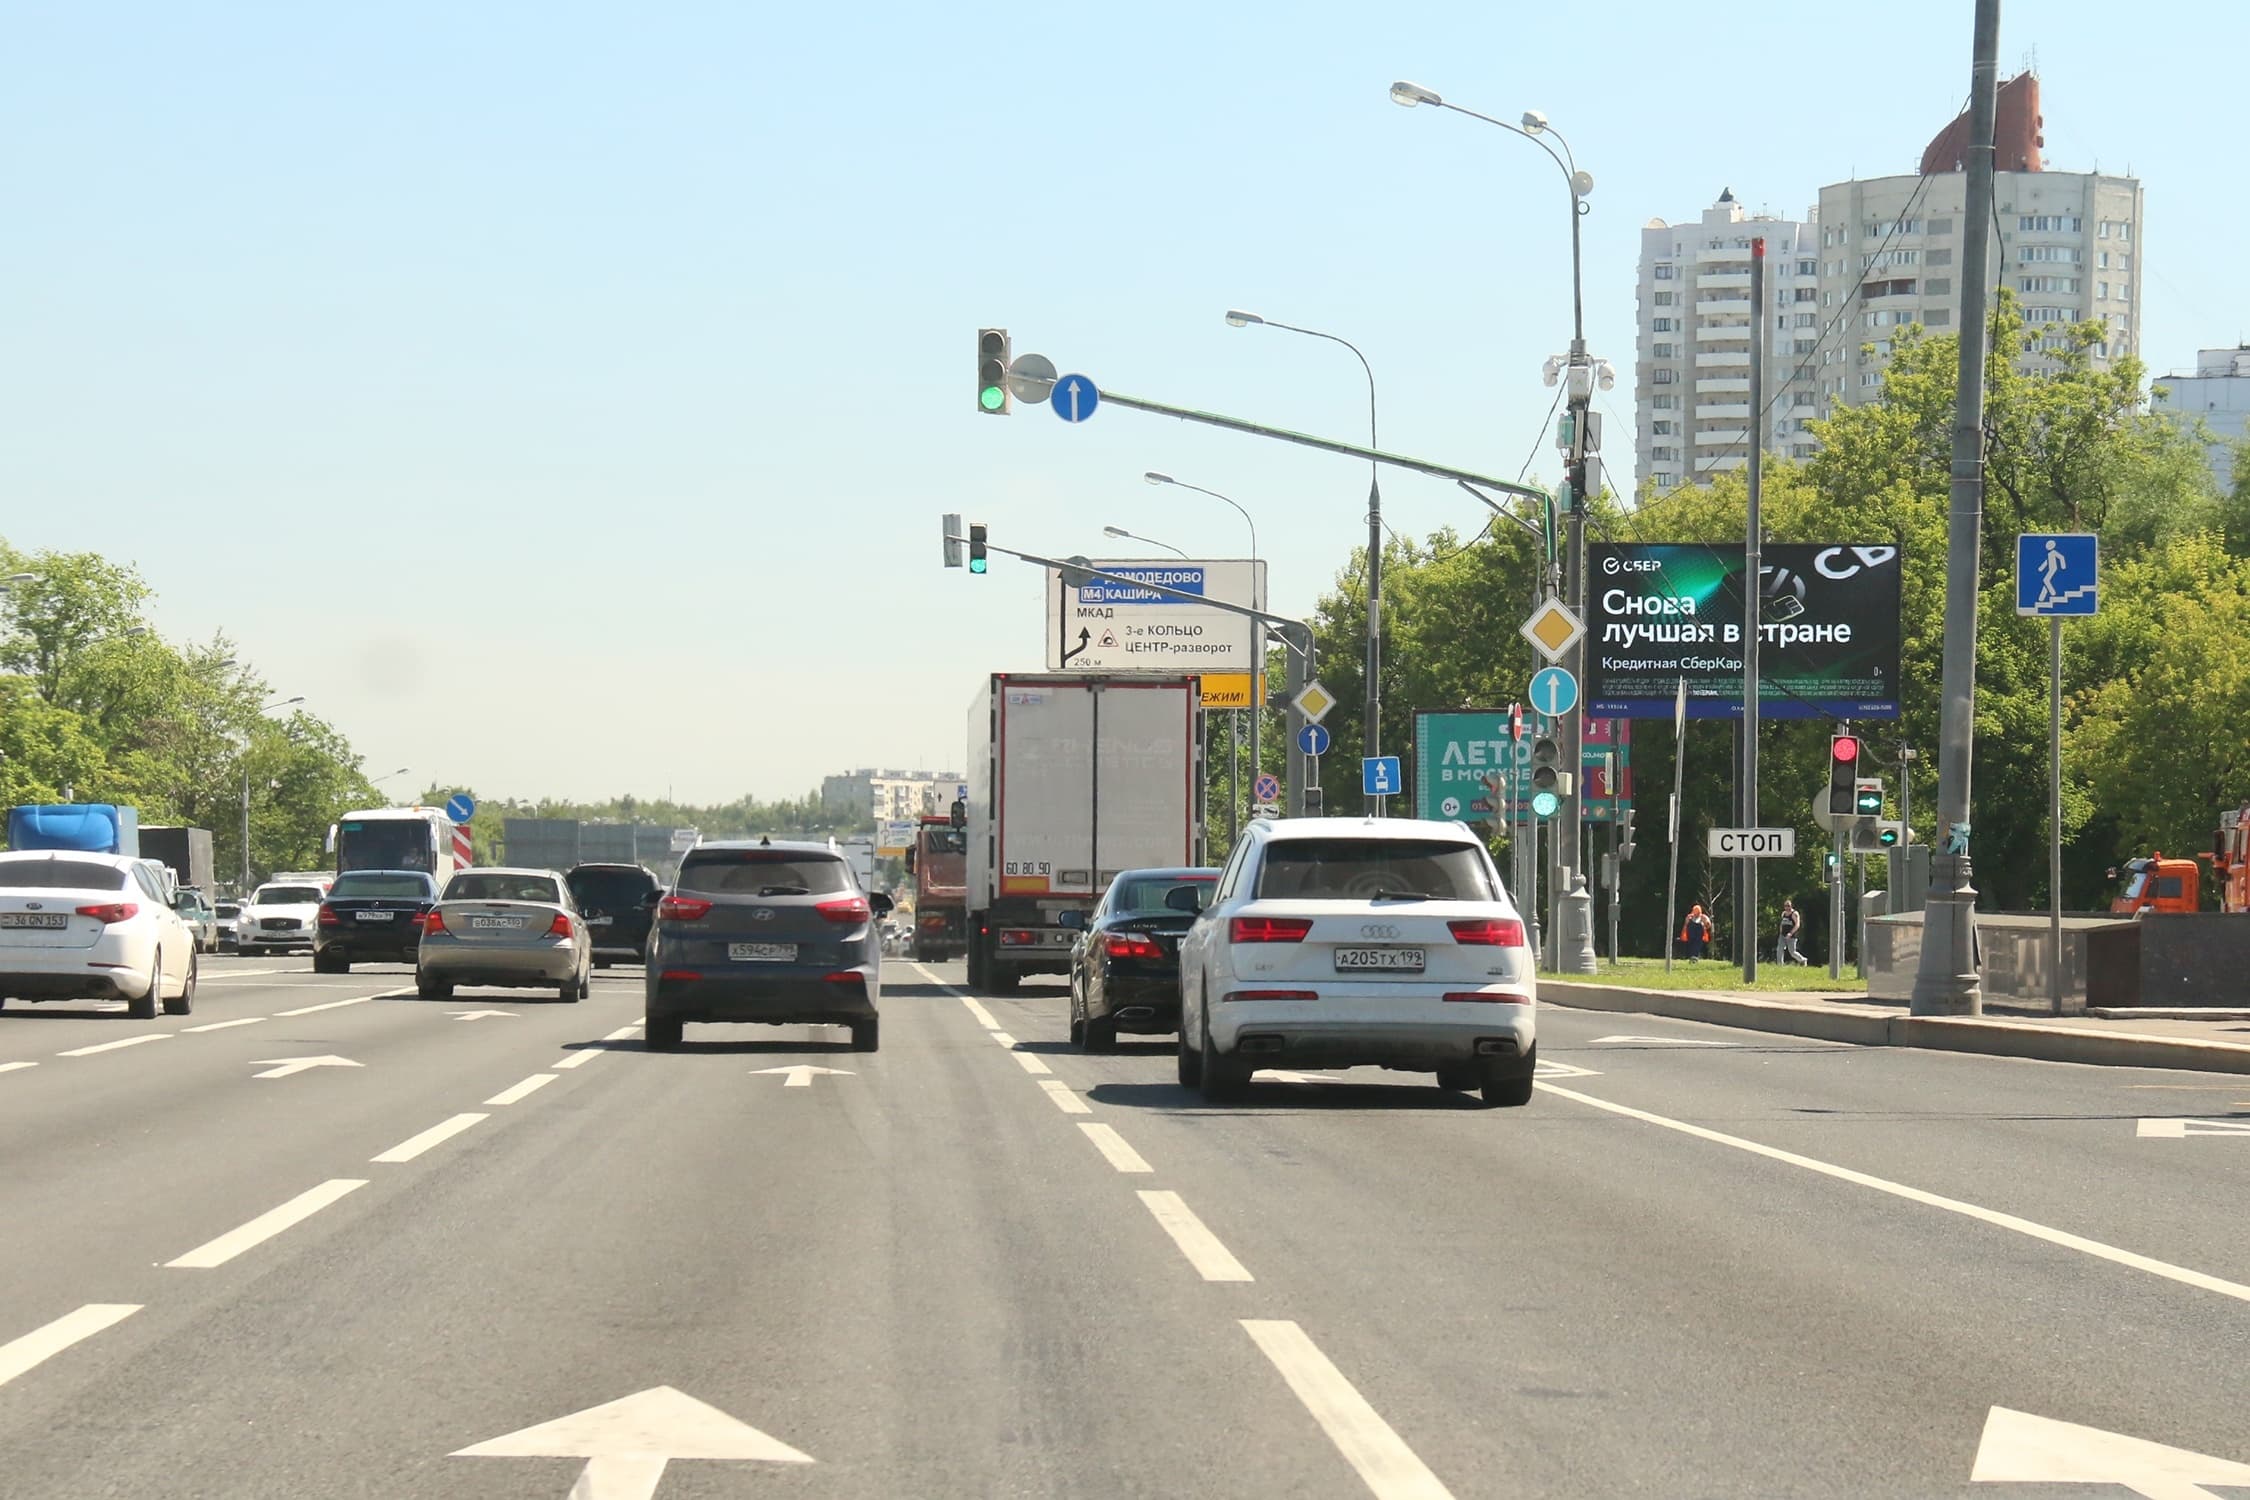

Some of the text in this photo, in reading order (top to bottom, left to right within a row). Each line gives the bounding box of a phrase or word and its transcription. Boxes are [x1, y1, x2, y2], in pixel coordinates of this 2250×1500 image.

[1623, 560, 1662, 572] СБЕР
[1106, 588, 1162, 600] КАШИРА
[1602, 589, 1696, 615] Снова
[1077, 607, 1113, 619] МКАД
[1125, 625, 1203, 637] 3-е КОЛЬЦО
[1602, 623, 1714, 649] лучшая
[1723, 623, 1740, 642] в
[1125, 642, 1232, 654] ЦЕНТР-разворот
[1074, 657, 1091, 666] 250
[1602, 656, 1745, 672] Кредитная СберКар
[1201, 692, 1244, 702] ЕЖИМ!
[1441, 740, 1532, 765] ЛЕТО
[1442, 769, 1453, 781] В
[1443, 802, 1458, 812] 0+
[1720, 834, 1782, 852] СТОП
[1006, 862, 1050, 875] 60 80 90
